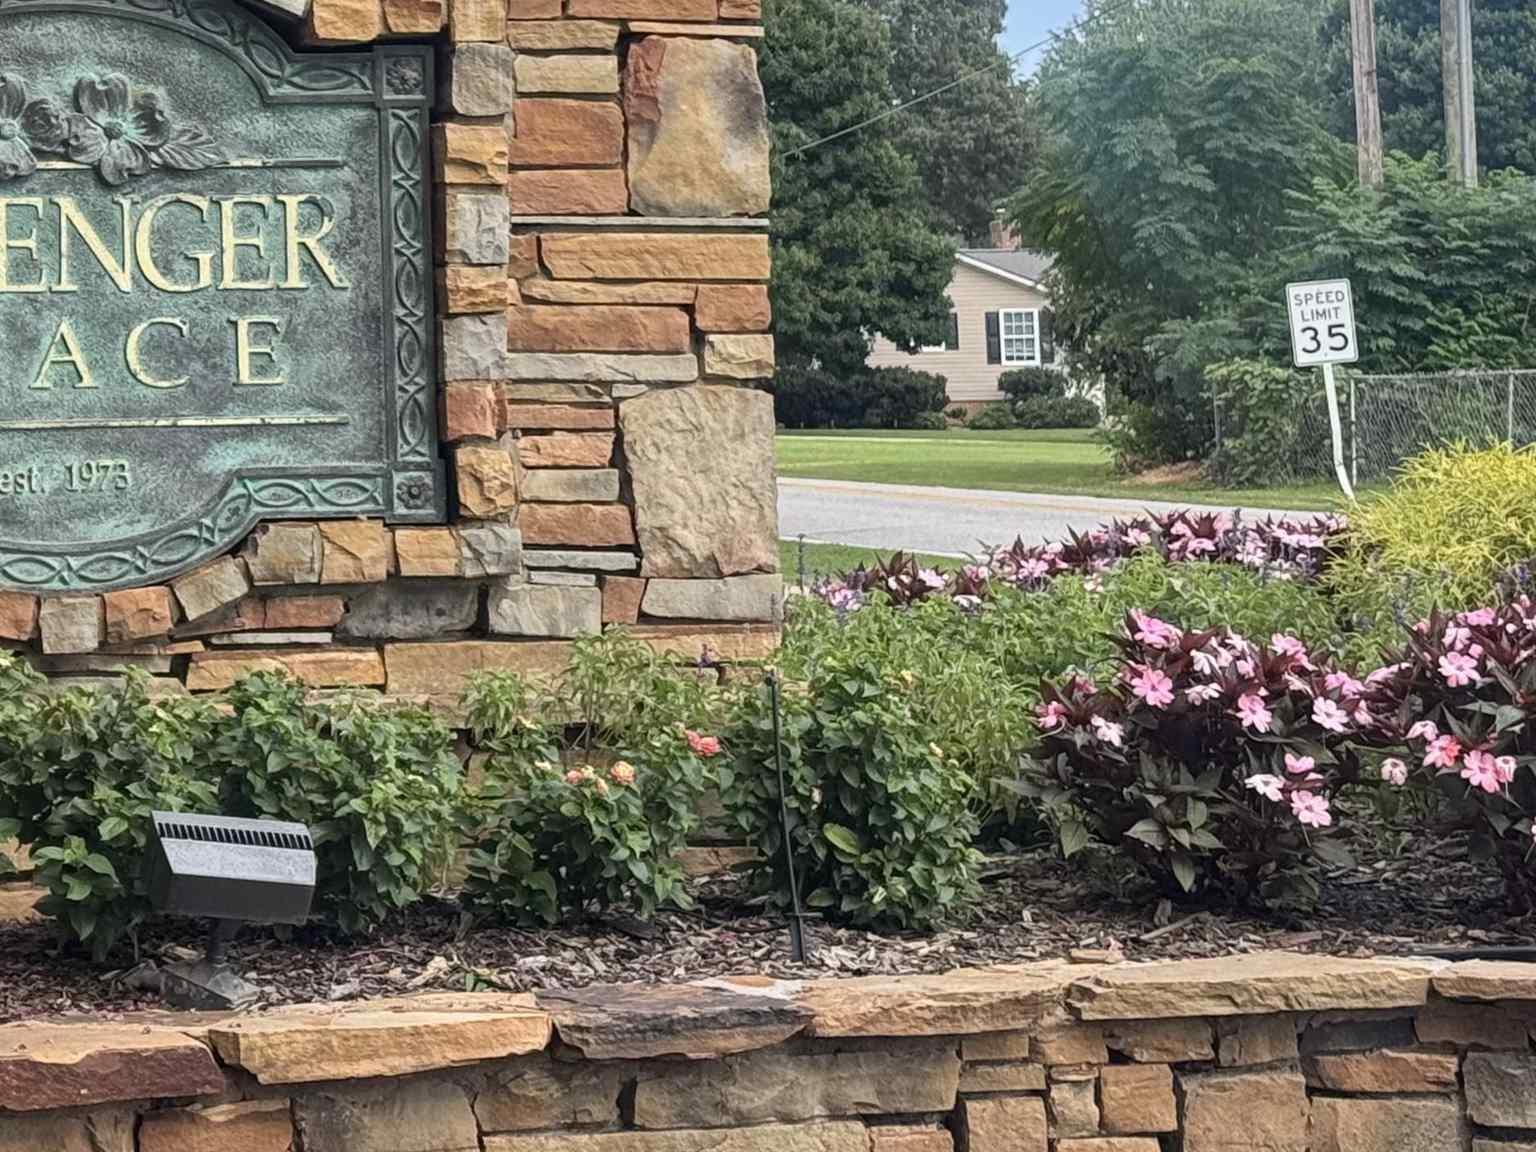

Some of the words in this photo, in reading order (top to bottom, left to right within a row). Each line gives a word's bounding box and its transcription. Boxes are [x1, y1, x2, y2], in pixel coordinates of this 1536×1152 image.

[1294, 290, 1345, 306] SPEED
[1300, 307, 1341, 322] LIMIT
[1301, 324, 1349, 353] 35
[64, 458, 130, 494] 1973
